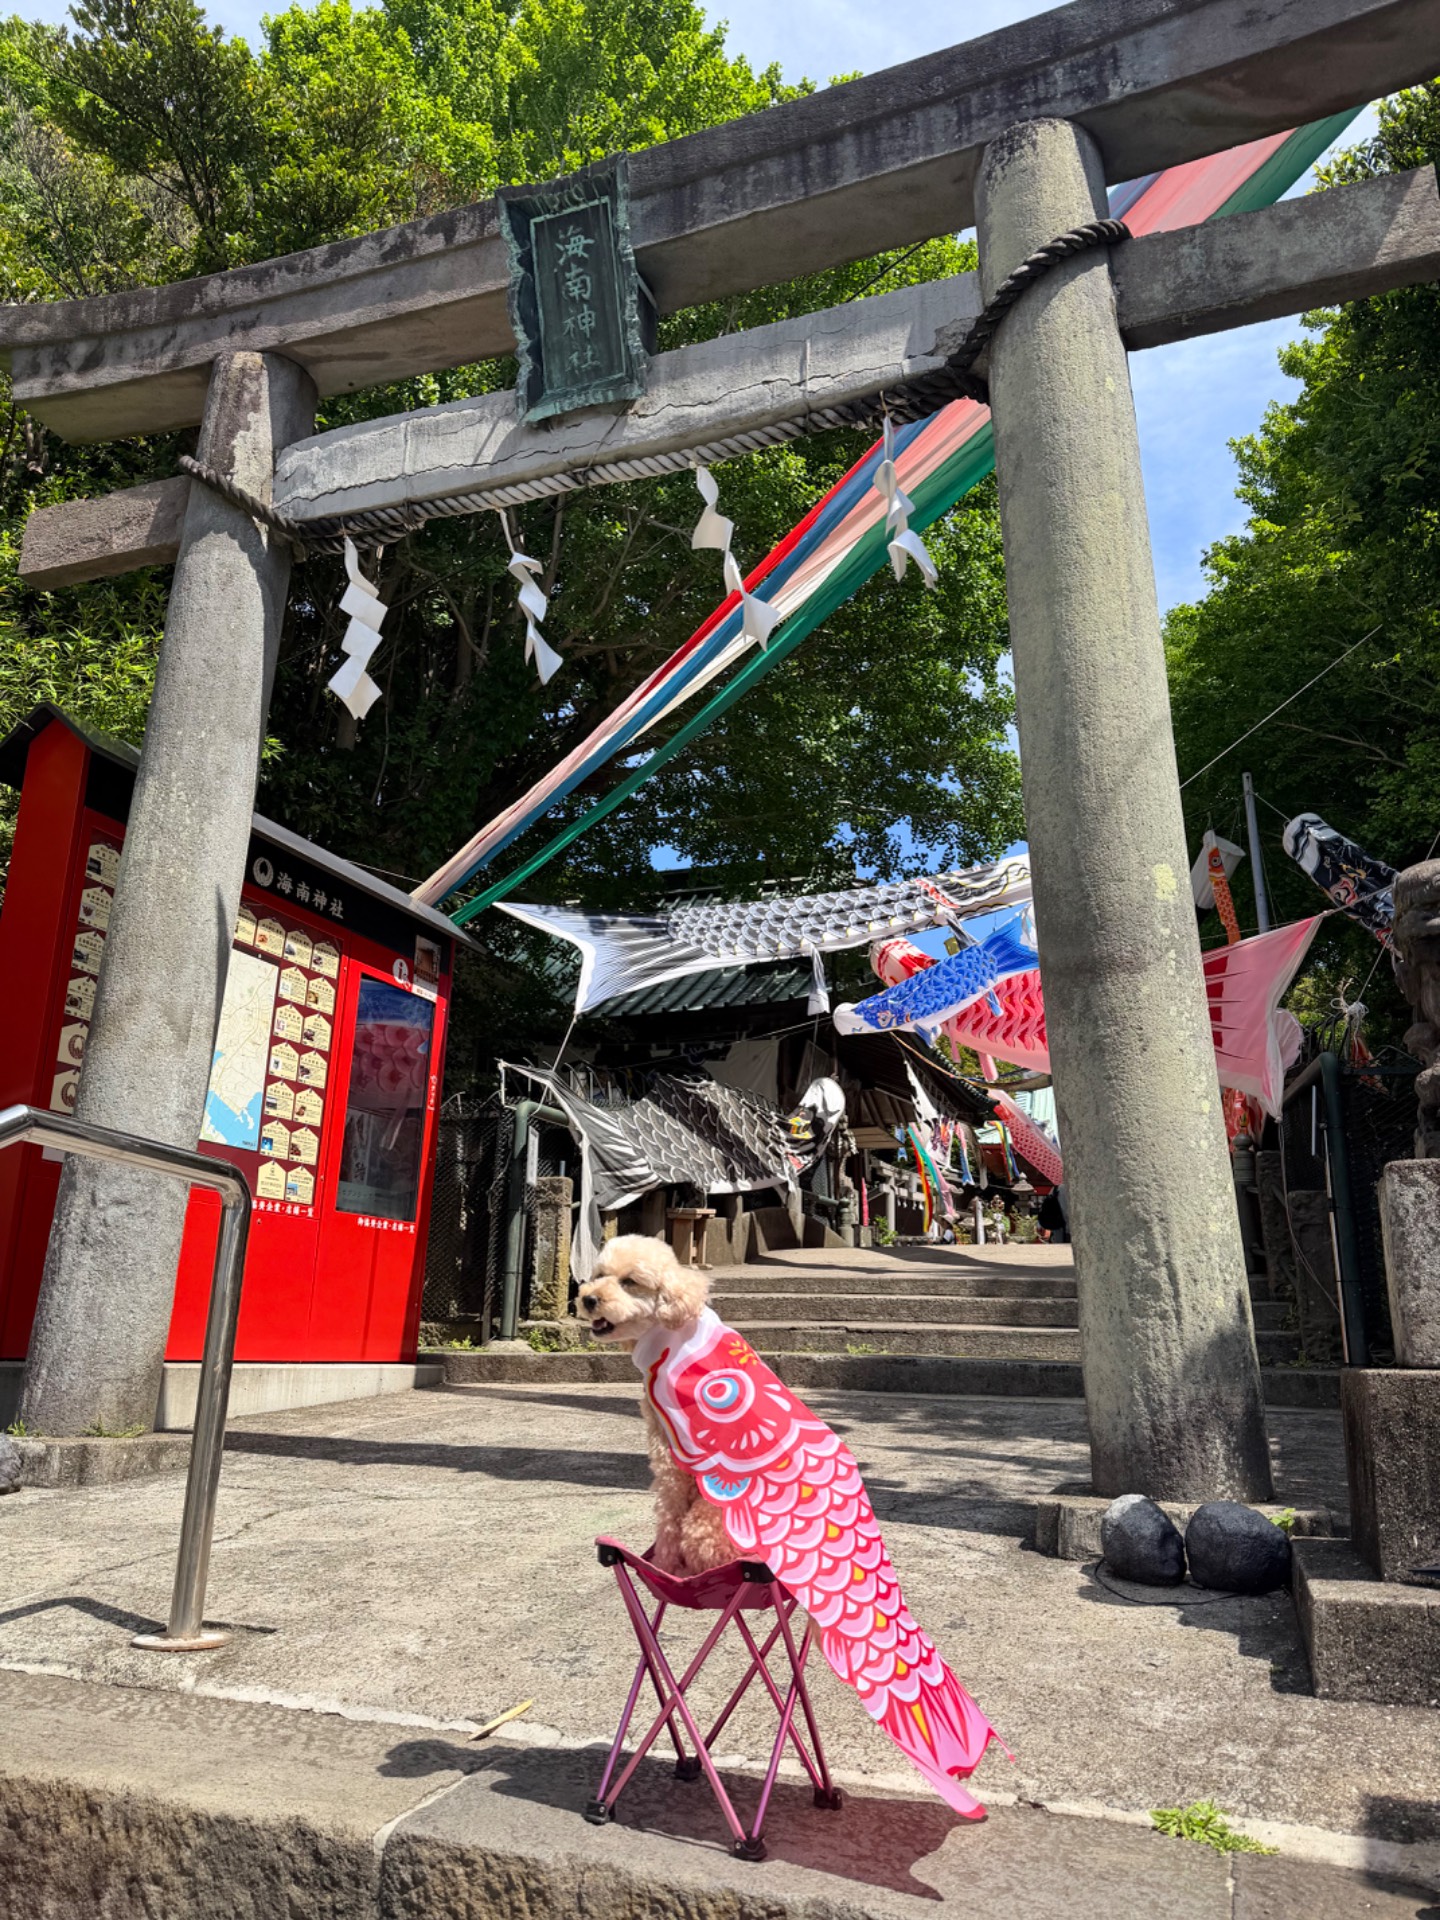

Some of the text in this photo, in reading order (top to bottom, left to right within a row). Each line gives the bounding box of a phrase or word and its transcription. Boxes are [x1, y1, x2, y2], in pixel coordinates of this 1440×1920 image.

[555, 225, 601, 374] 海南神社
[277, 871, 344, 919] 海南神社
